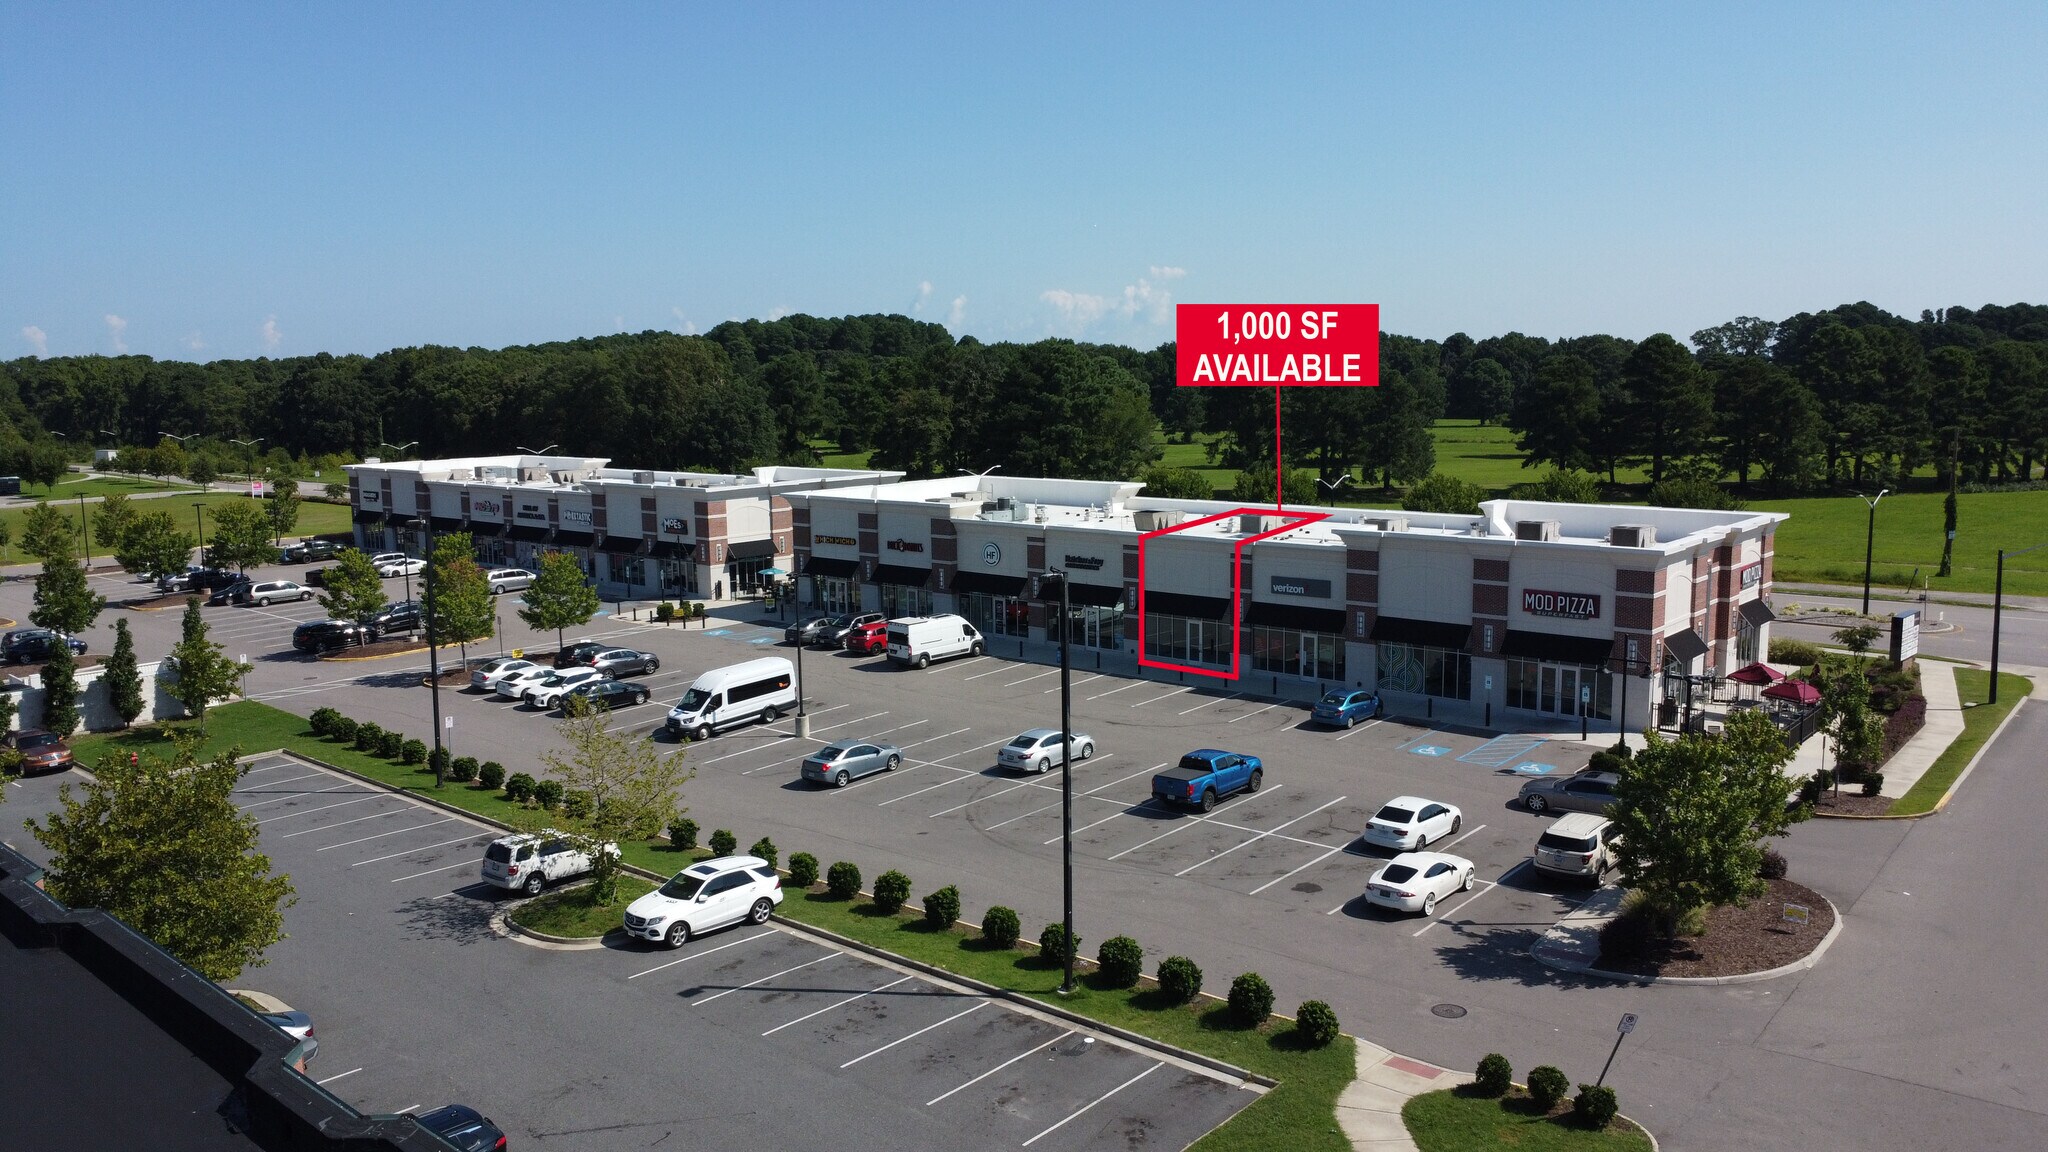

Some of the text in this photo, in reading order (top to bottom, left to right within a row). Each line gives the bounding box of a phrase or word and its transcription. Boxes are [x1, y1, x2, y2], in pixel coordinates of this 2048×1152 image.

[986, 551, 996, 560] HF
[1272, 584, 1304, 594] verizon
[1525, 593, 1595, 615] MOD PIZZA
